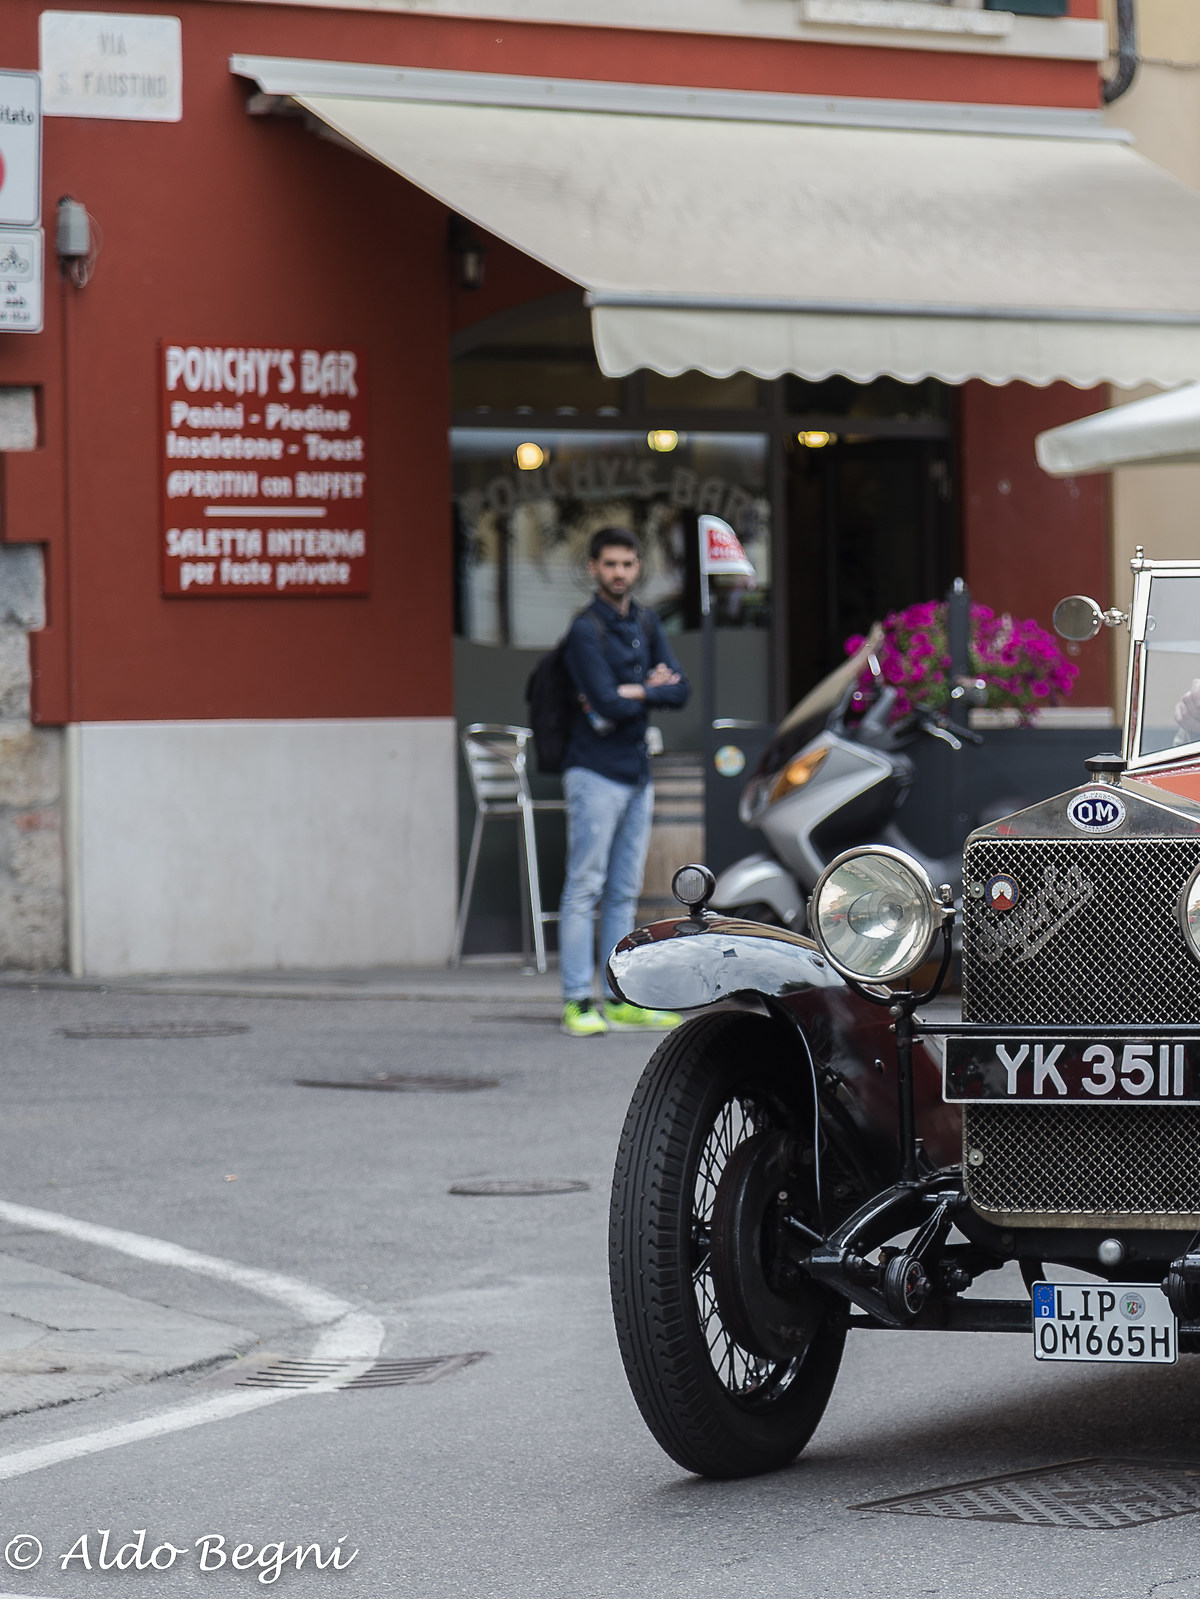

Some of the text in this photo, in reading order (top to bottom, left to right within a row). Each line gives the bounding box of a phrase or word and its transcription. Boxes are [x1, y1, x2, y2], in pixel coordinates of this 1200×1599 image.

[99, 33, 127, 57] VIA
[82, 72, 168, 98] FAUSTINO
[166, 346, 359, 398] PONCHY'S BAR
[170, 400, 244, 430] Panini
[265, 403, 351, 431] Piadine
[166, 431, 284, 460] Insalatone
[304, 433, 365, 461] Toast
[167, 470, 366, 500] APERITIVI con BUFFET
[166, 528, 366, 558] SALETTA INTERNA
[180, 557, 351, 590] per feste private
[1077, 801, 1114, 823] OM
[995, 1044, 1068, 1096] YK
[1041, 1305, 1050, 1317] D
[1056, 1289, 1116, 1322] LIP
